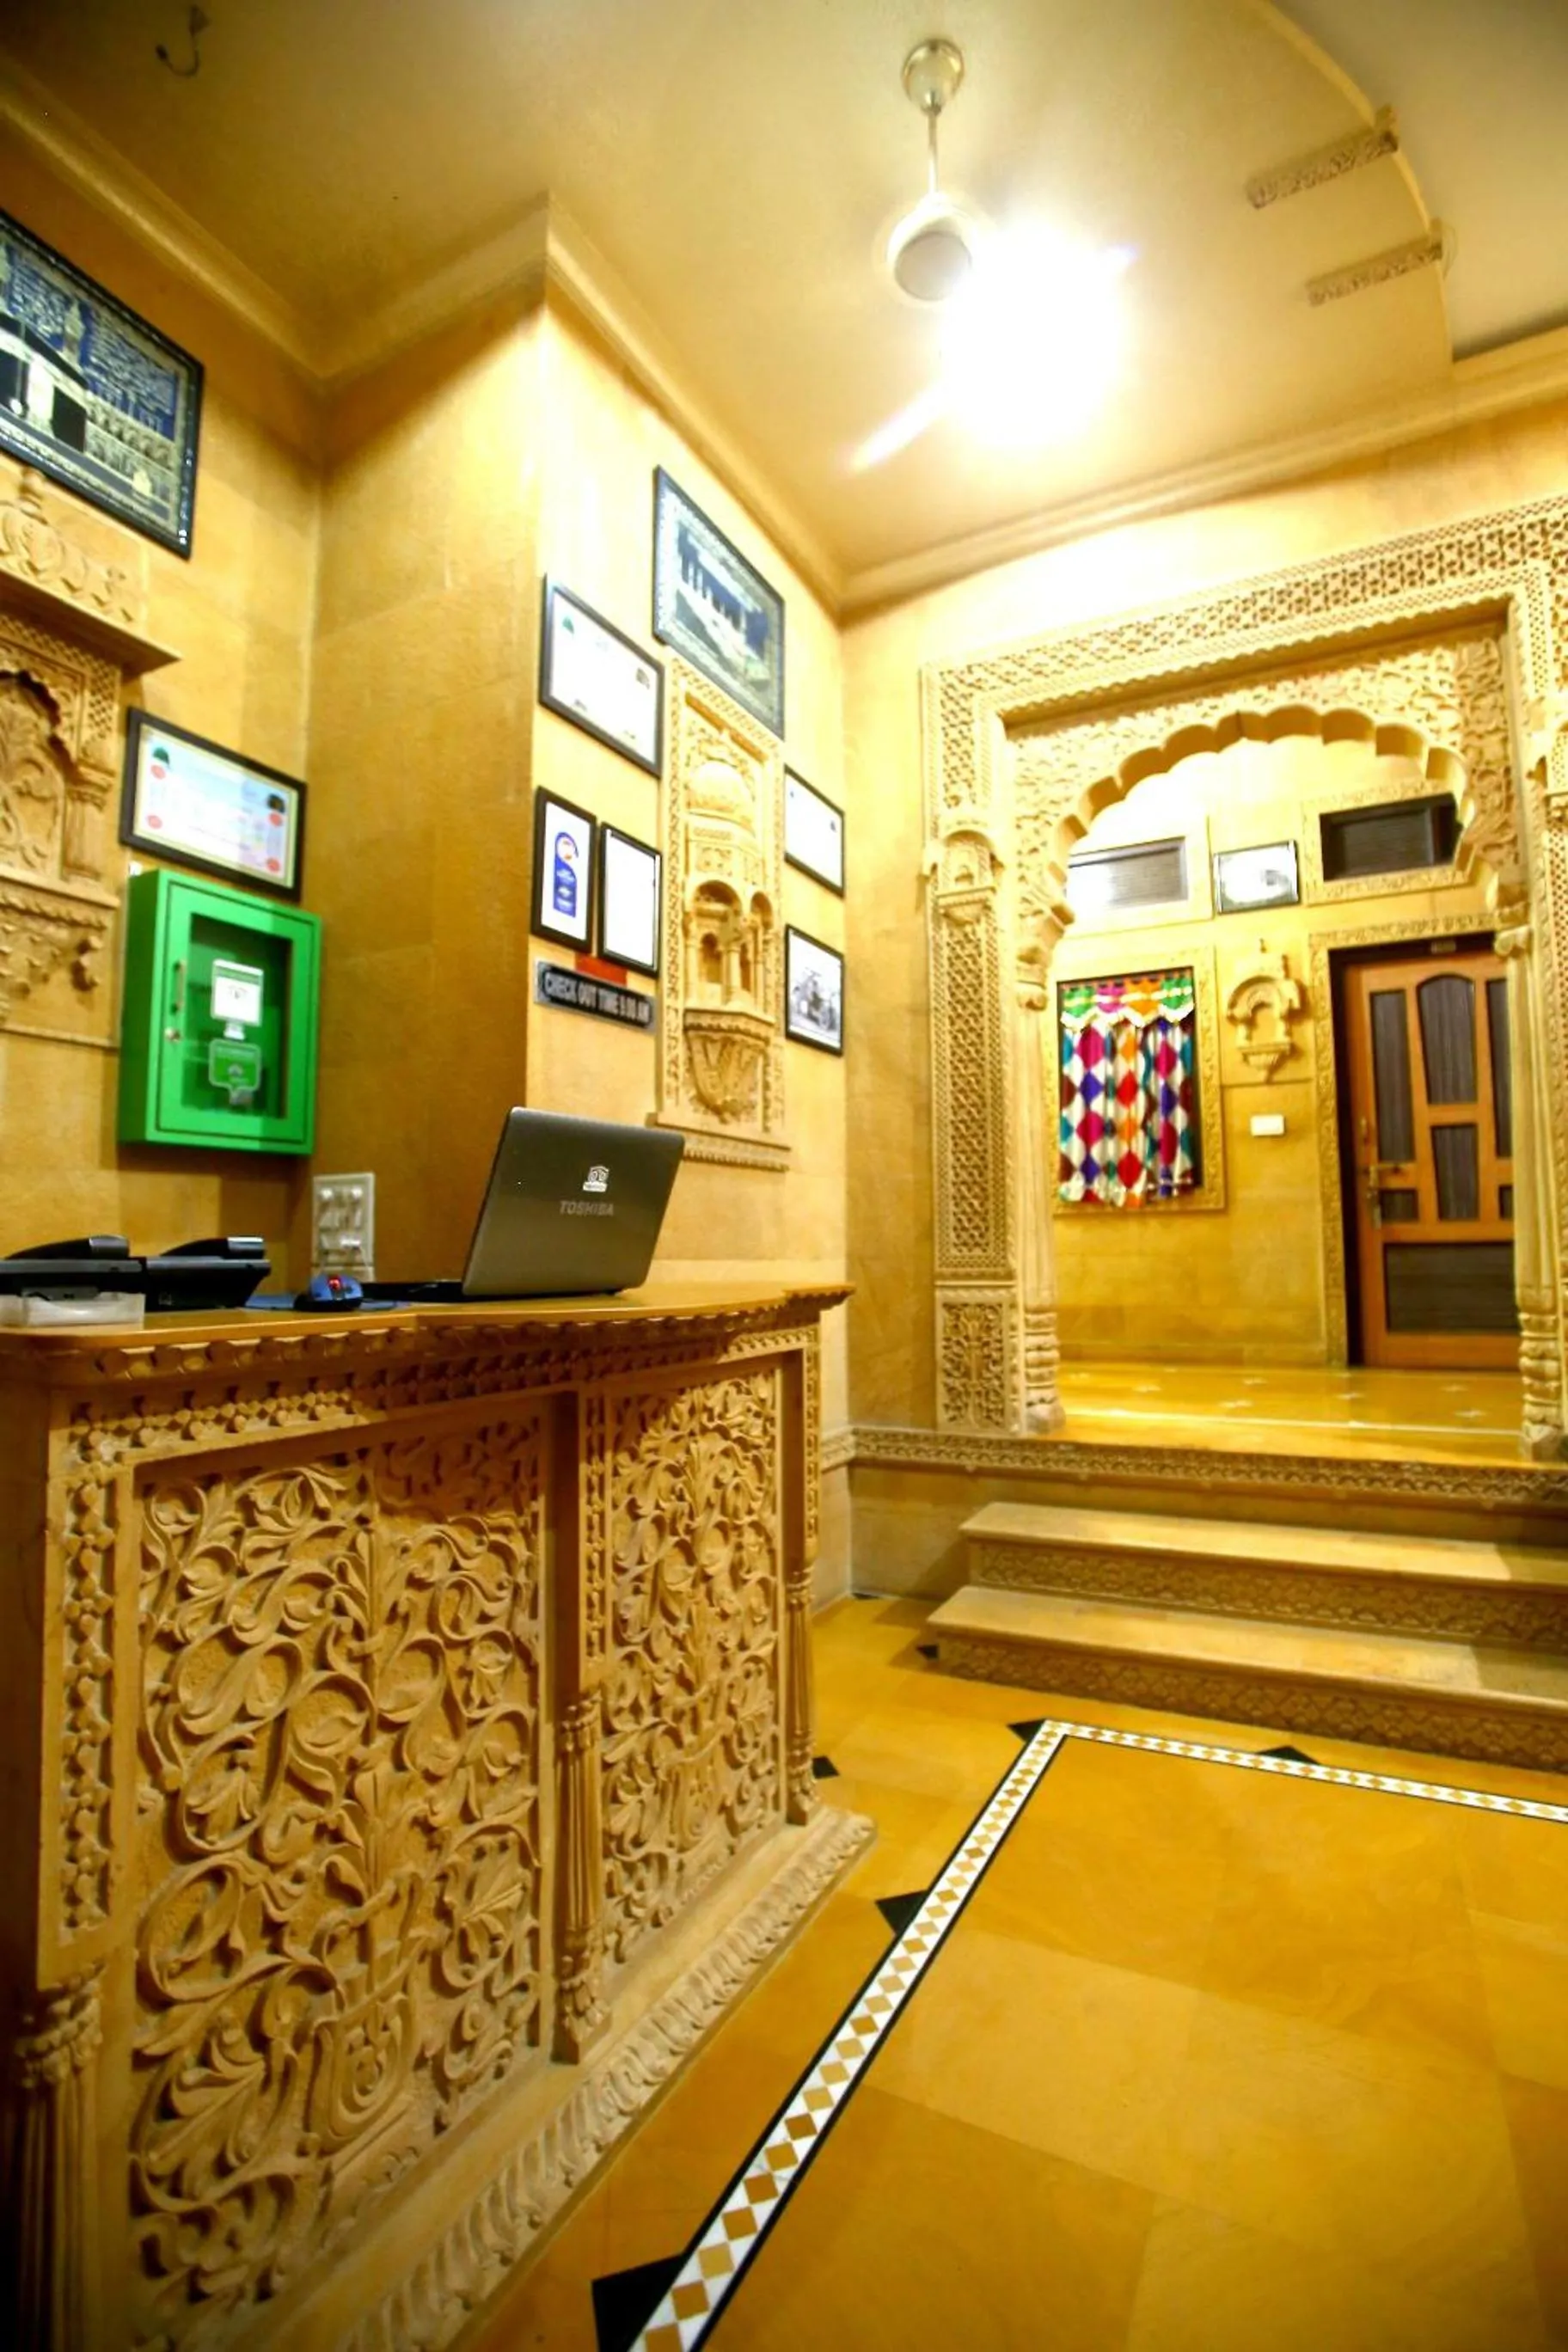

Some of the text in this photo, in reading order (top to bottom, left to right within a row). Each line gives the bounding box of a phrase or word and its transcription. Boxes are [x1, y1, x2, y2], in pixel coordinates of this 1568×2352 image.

[545, 971, 578, 1003] CHECK
[579, 981, 597, 1009] OUT
[560, 1200, 614, 1216] TOSHIBA
